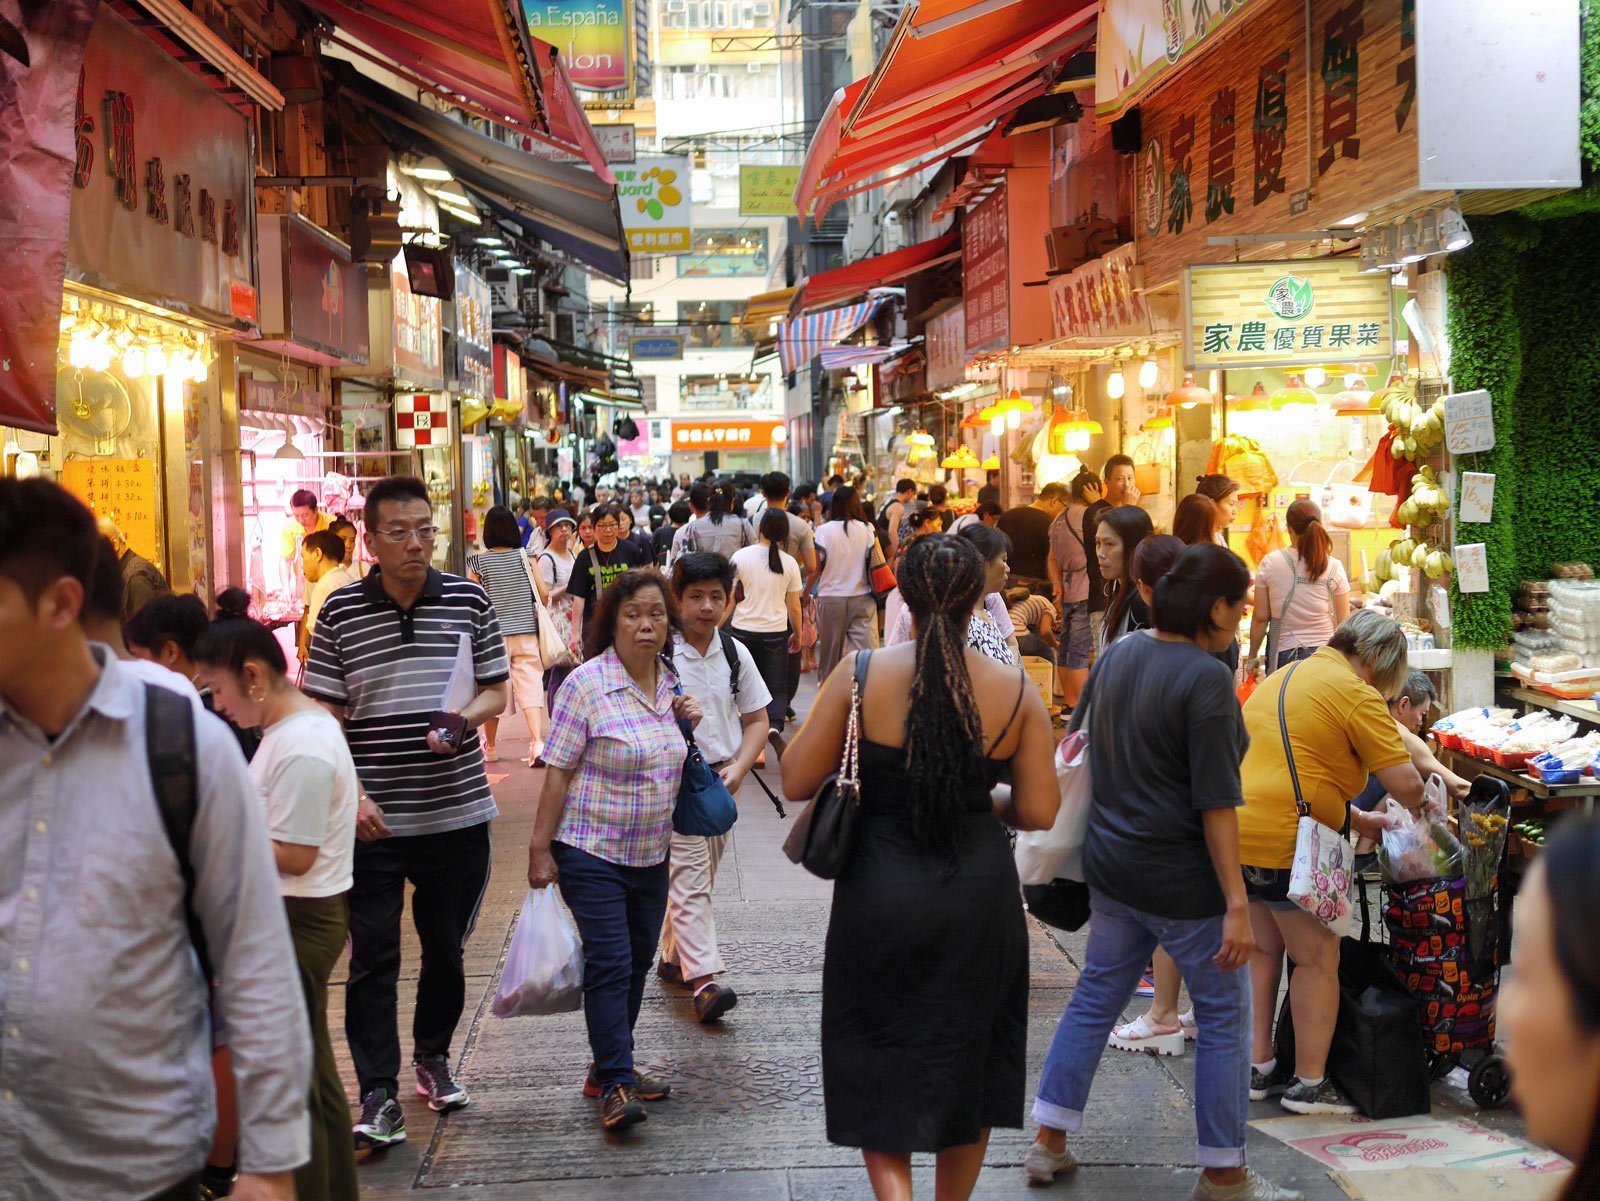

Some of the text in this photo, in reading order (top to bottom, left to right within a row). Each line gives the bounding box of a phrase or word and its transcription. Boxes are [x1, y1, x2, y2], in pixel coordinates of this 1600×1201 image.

[548, 4, 619, 40] España
[1167, 0, 1417, 236] 家農優質
[626, 233, 683, 247] 便利超市
[1202, 320, 1382, 353] 家農優質果菜
[1417, 902, 1435, 912] Tasty
[1456, 992, 1480, 1003] Oyster
